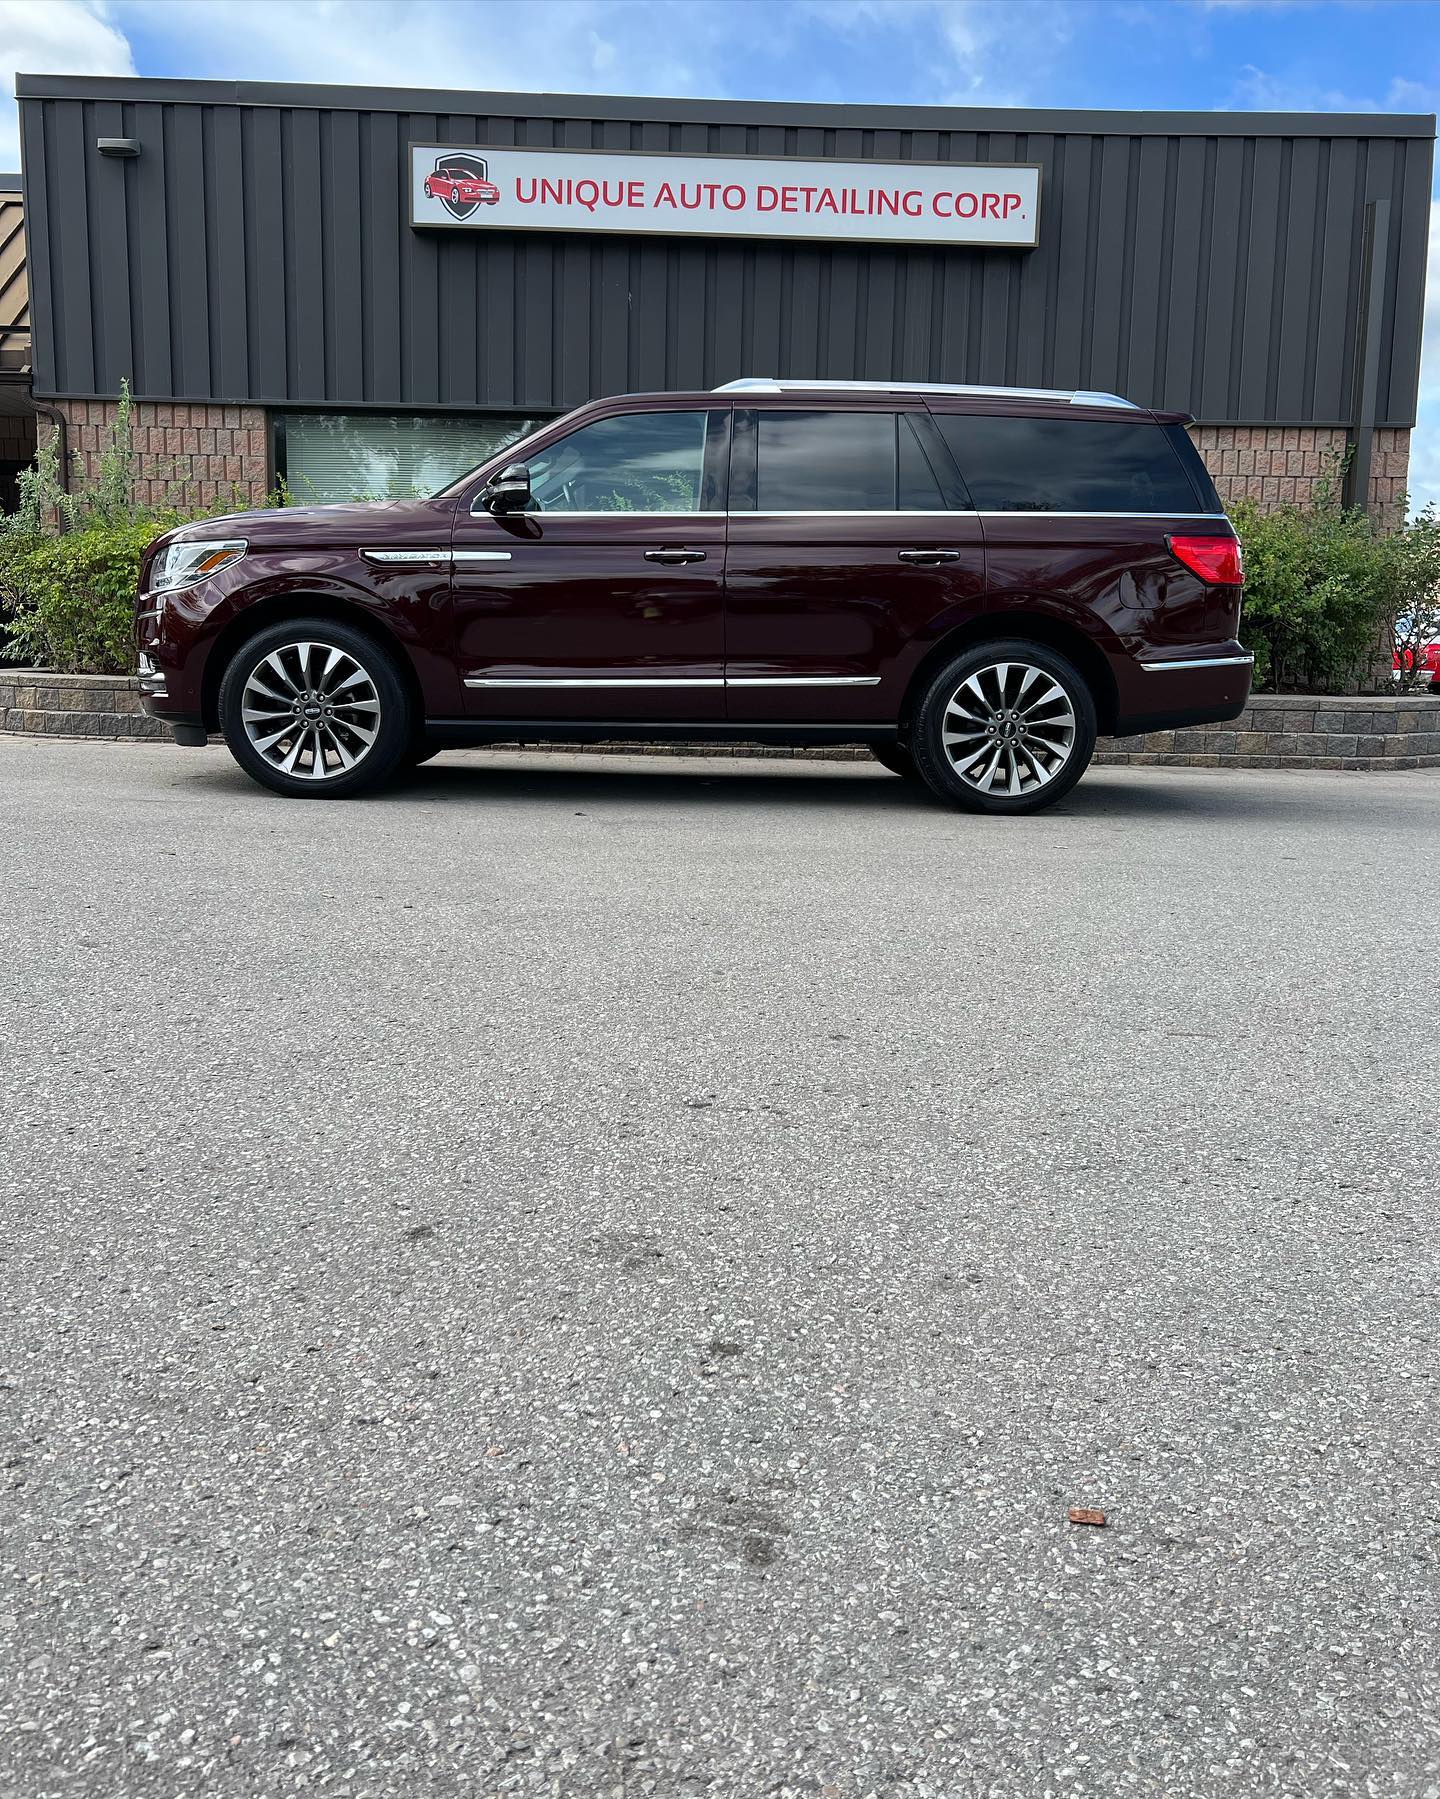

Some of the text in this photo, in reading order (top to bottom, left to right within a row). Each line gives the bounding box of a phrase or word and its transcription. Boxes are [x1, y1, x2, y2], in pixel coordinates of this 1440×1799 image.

[516, 177, 1027, 219] UNIQUE AUTO DETAILING CORP.
